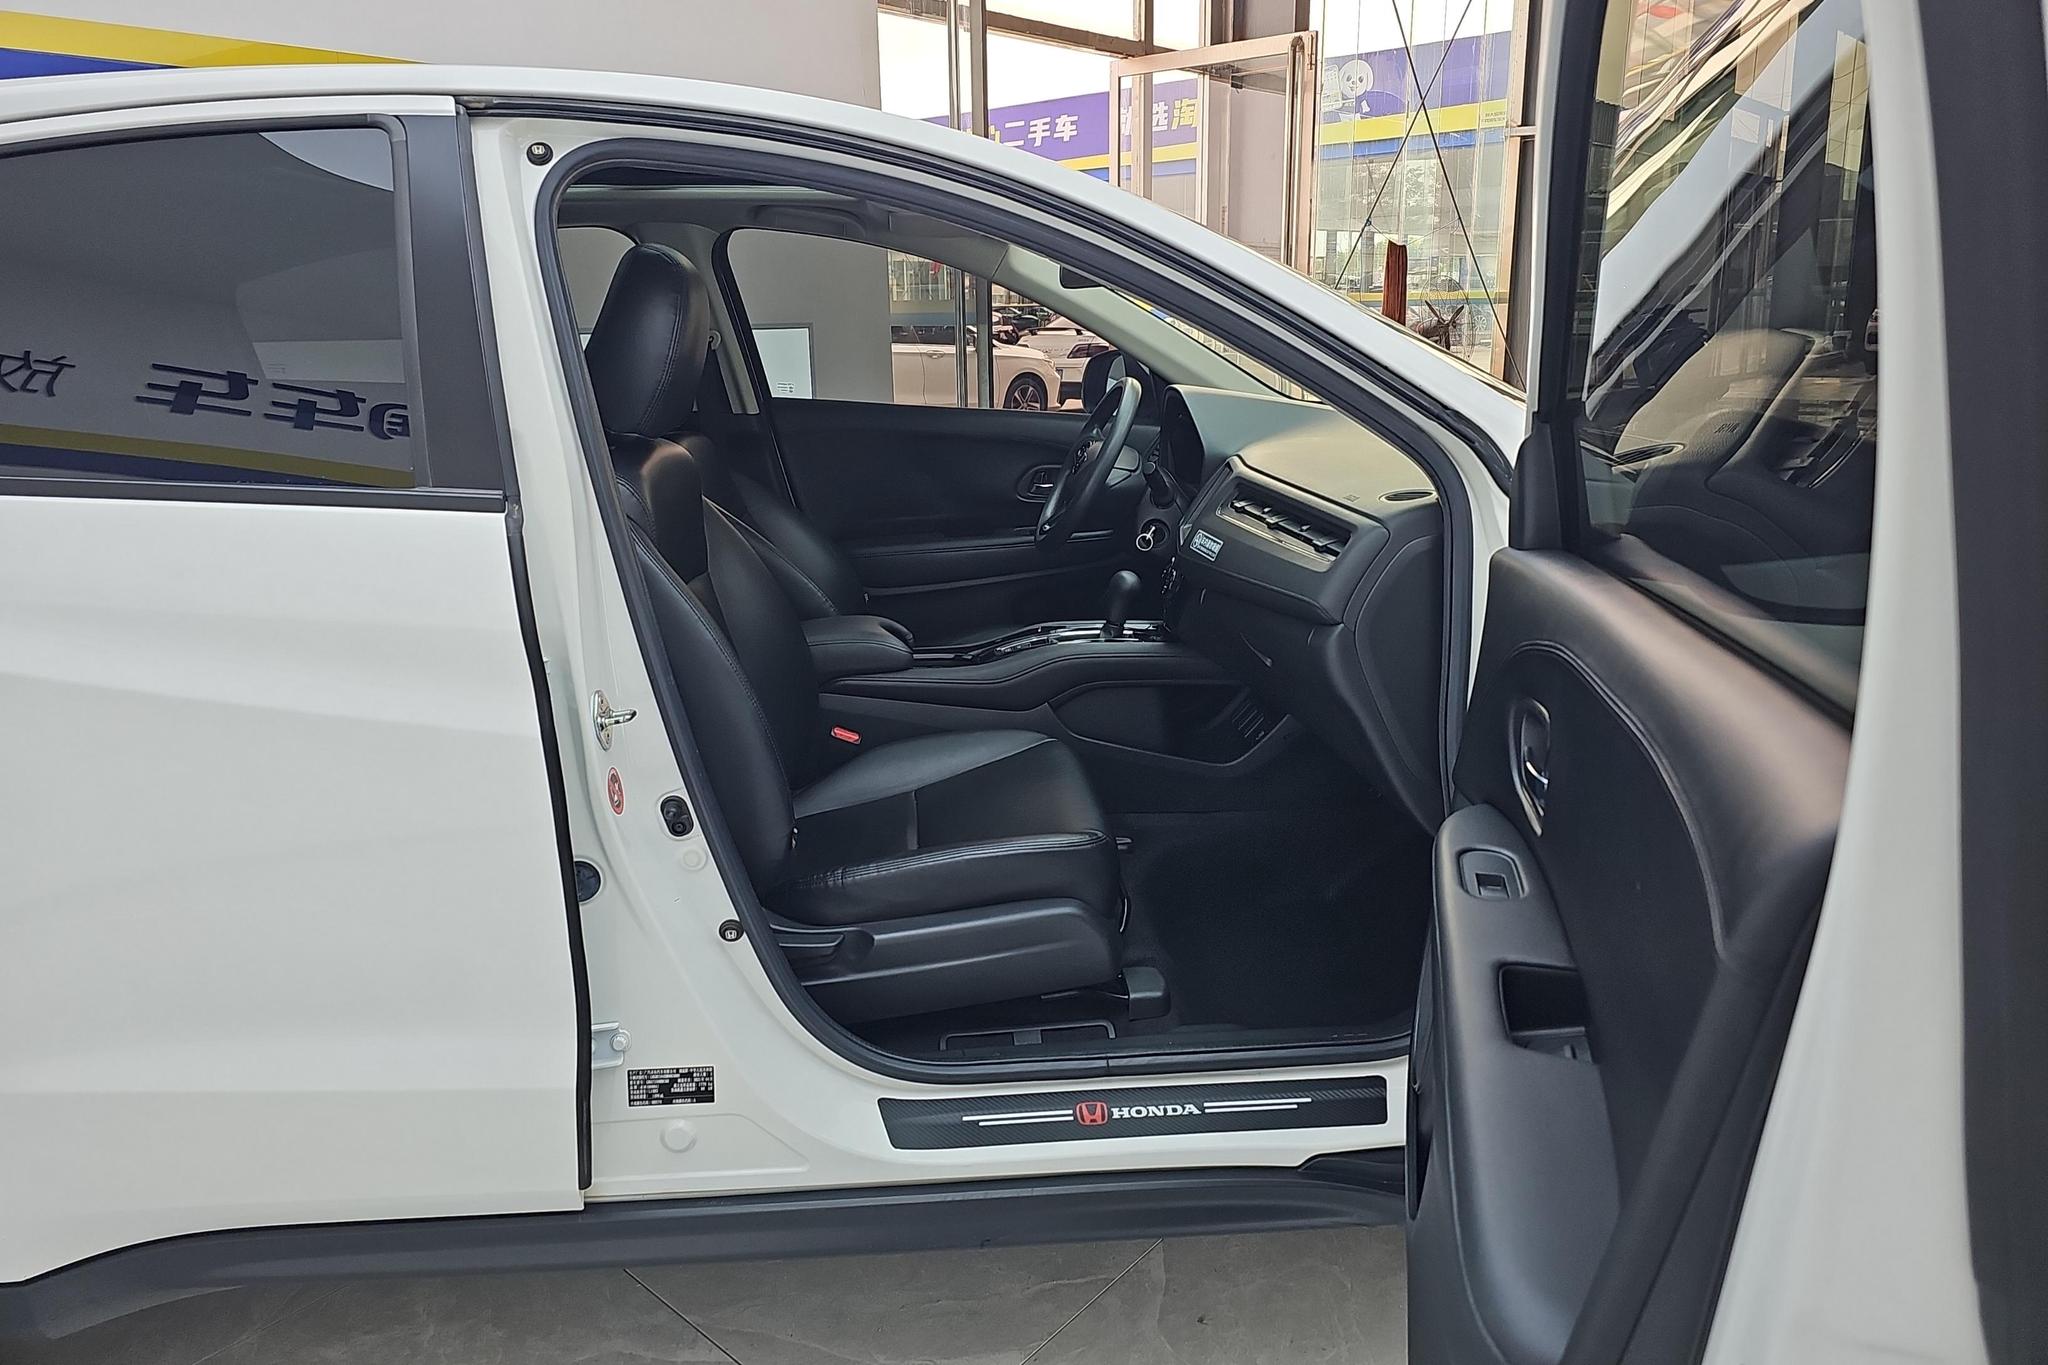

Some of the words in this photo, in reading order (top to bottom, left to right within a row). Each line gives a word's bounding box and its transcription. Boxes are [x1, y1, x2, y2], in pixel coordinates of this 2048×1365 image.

[988, 114, 1079, 148] 二手车
[1110, 1103, 1202, 1119] HONDA
